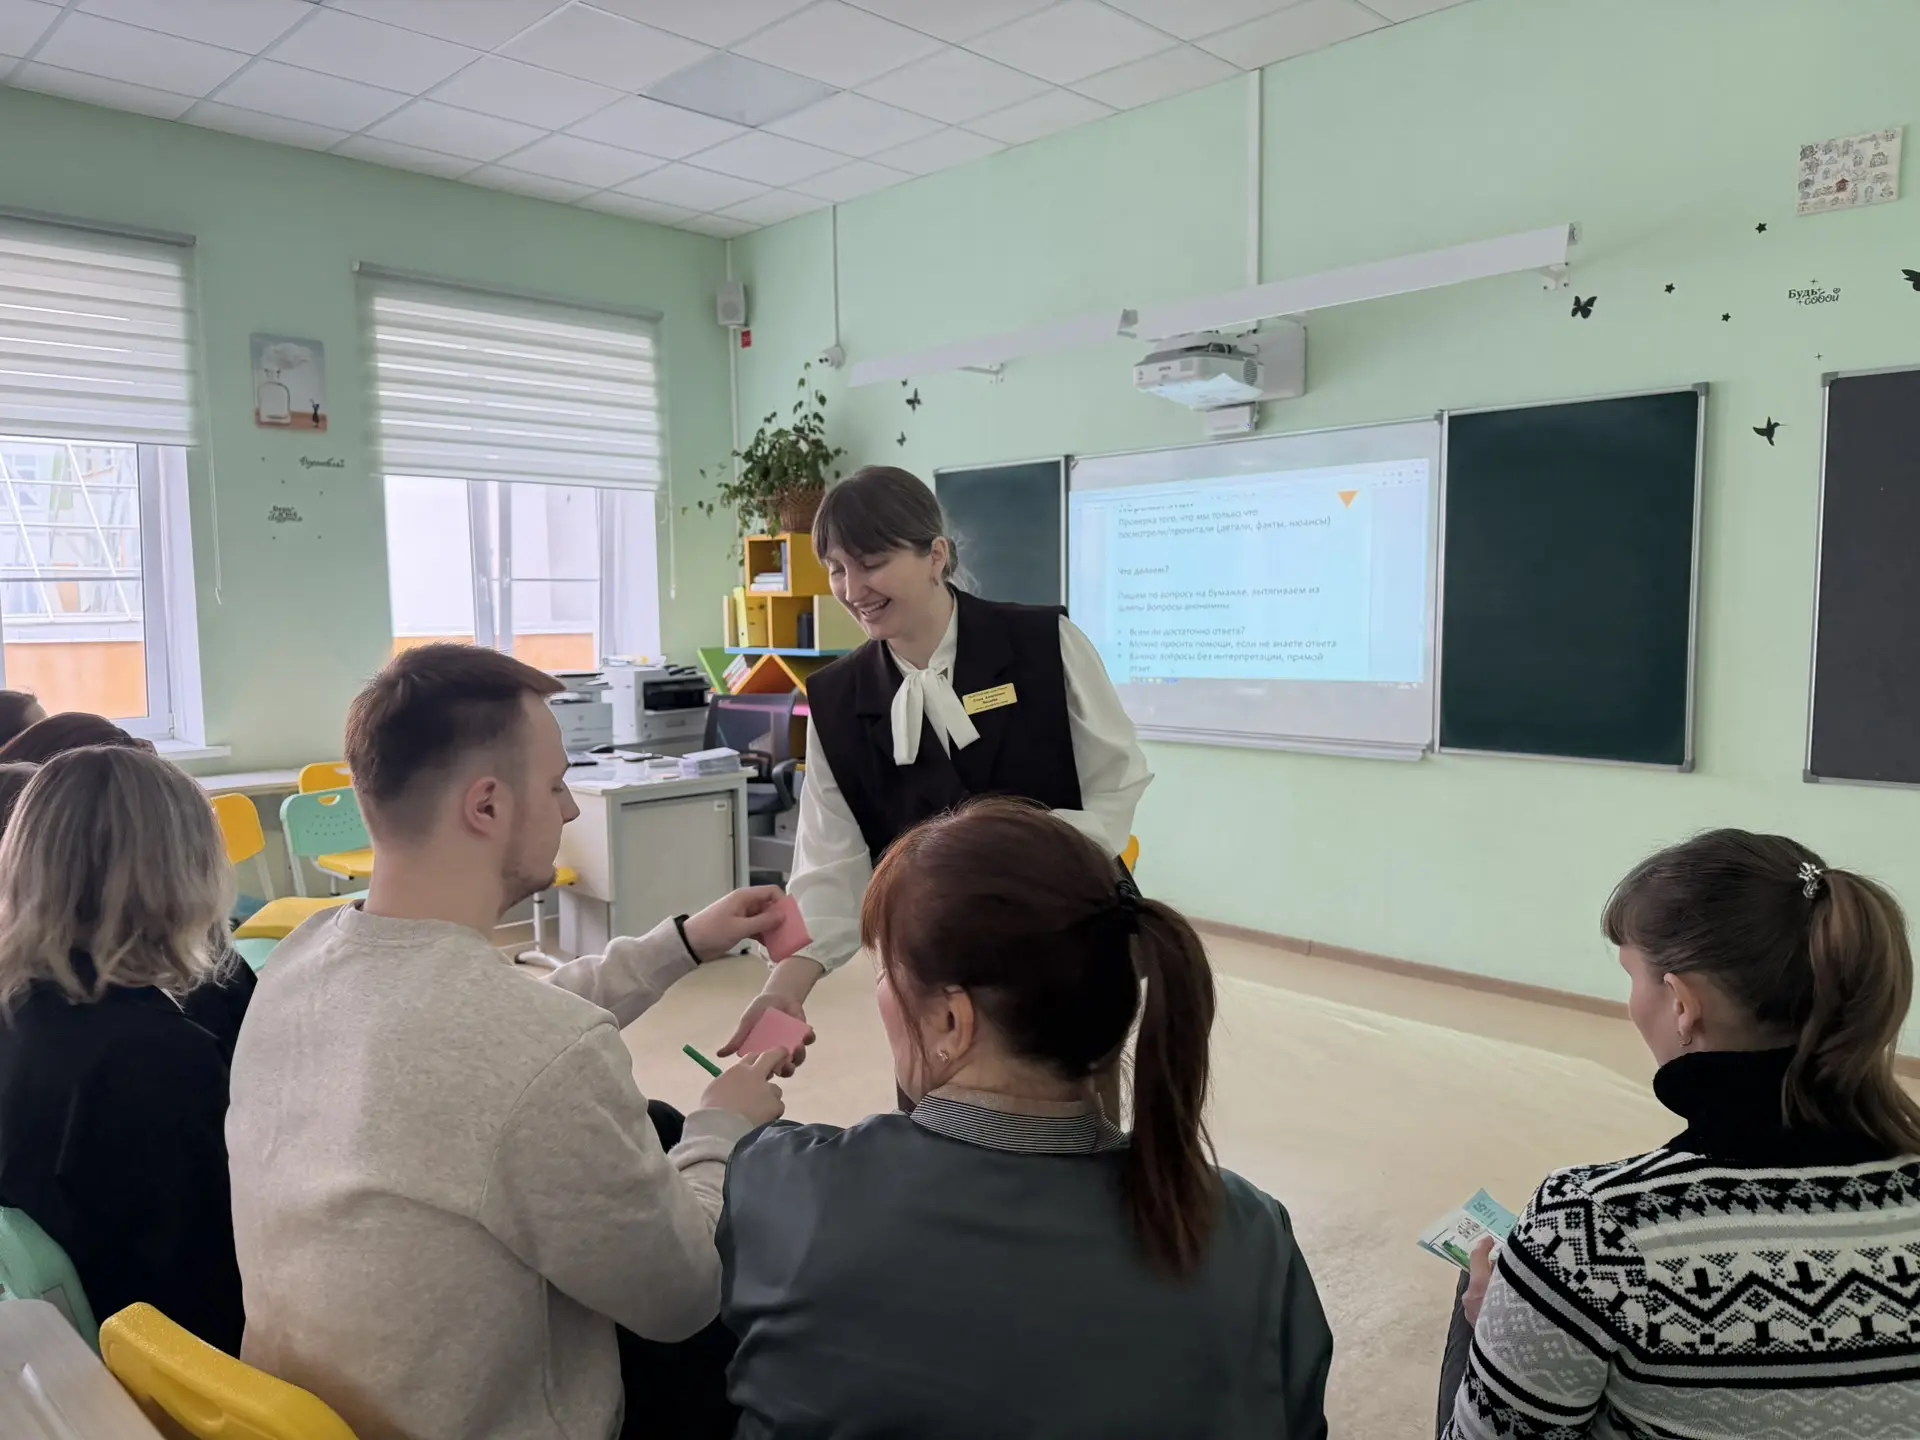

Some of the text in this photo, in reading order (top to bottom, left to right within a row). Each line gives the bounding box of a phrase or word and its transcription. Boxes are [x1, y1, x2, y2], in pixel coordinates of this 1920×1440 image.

[1788, 289, 1818, 300] Будь
[1805, 288, 1840, 305] собой
[1118, 517, 1157, 527] Проверка
[1159, 515, 1177, 525] того,
[1180, 514, 1194, 522] что
[1212, 511, 1242, 520] только
[1243, 509, 1258, 517] что
[1118, 524, 1214, 539] посмотрели/прочитали
[1289, 515, 1331, 527] нюансы)
[1118, 565, 1170, 576] Что делаем?
[1160, 590, 1193, 600] вопросу
[1308, 585, 1320, 594] из
[1163, 628, 1210, 637] достаточно
[1212, 626, 1246, 636] ответа?
[1129, 639, 1337, 649] Можно просить помощи, если не знаете ответа
[1159, 652, 1195, 662] вопросы
[1197, 650, 1212, 660] без
[1213, 652, 1285, 663] интерпретации,
[1286, 651, 1324, 662] прямой
